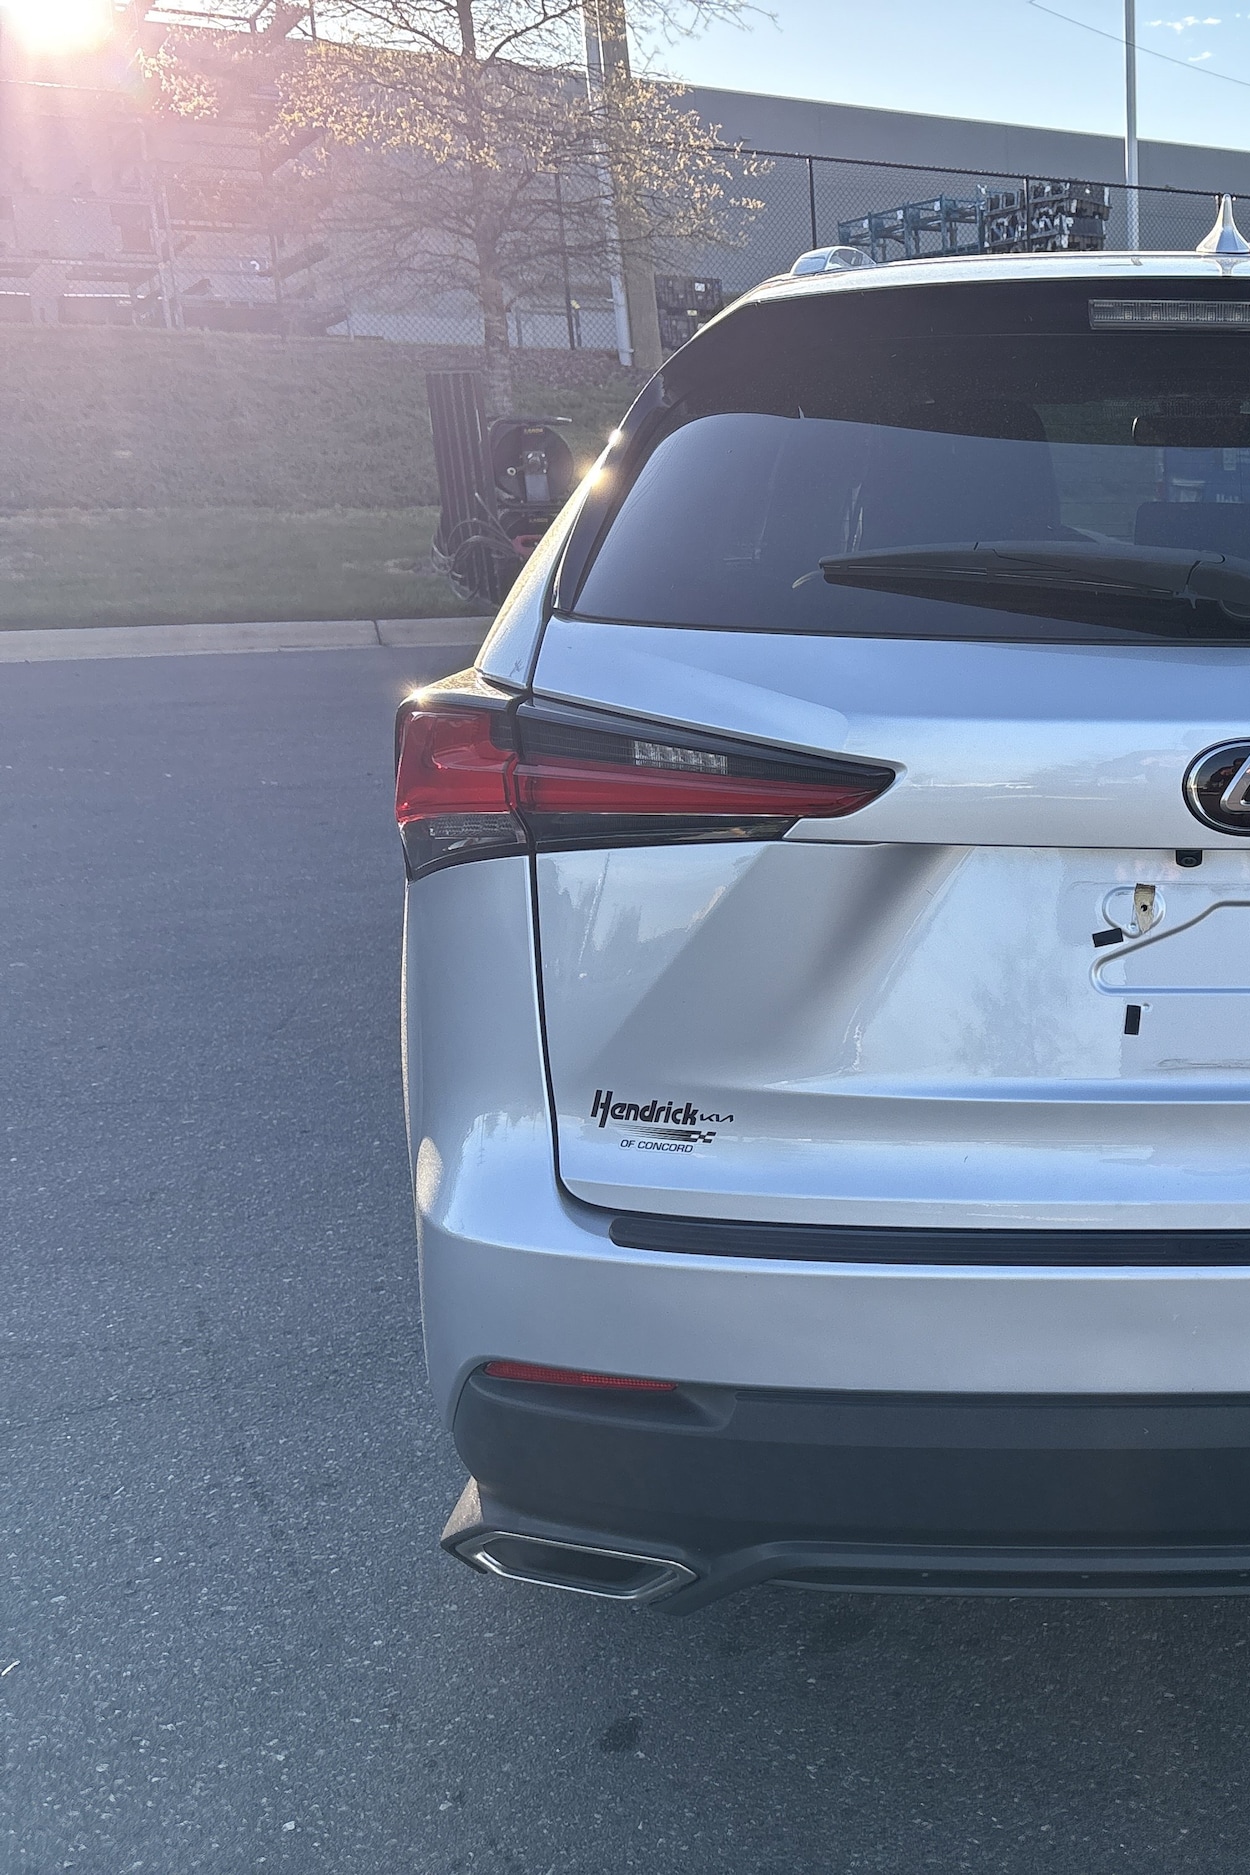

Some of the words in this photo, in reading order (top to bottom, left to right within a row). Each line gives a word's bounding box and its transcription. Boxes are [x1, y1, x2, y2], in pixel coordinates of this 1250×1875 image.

[590, 1089, 700, 1128] Hendrick
[620, 1139, 635, 1148] OF
[637, 1140, 694, 1153] CONCORD
